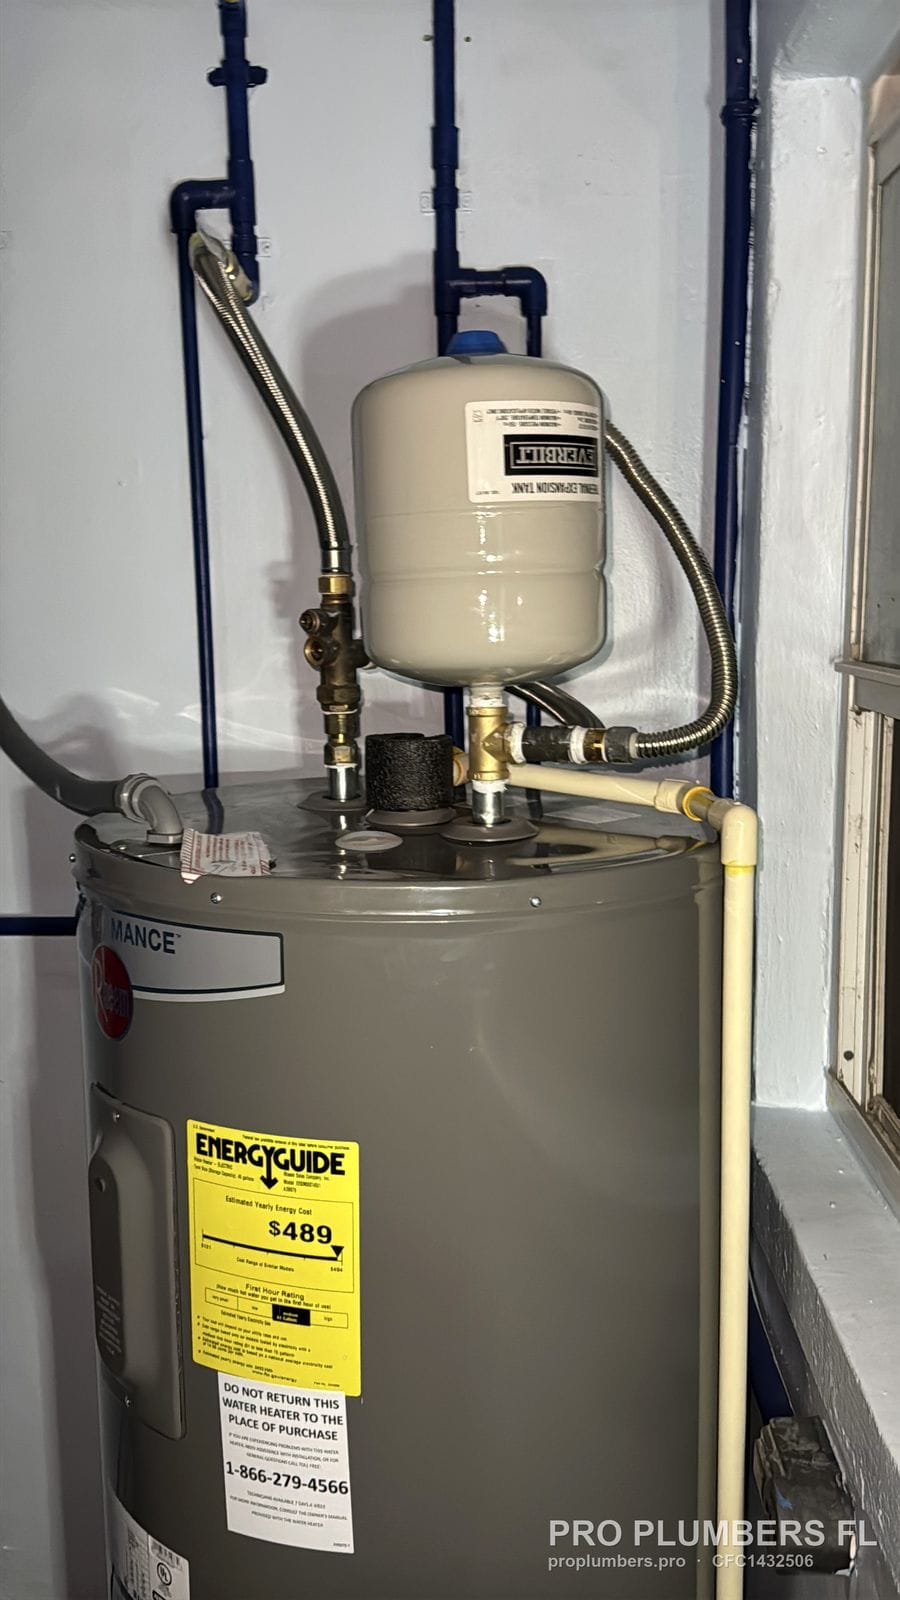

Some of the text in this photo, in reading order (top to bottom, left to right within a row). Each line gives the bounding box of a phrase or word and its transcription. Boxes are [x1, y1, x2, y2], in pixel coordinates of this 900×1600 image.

[516, 446, 595, 464] EVERBILT
[512, 482, 535, 494] TANK
[536, 482, 577, 494] EXPANSION
[196, 1132, 346, 1176] ENERGYGUIDE
[225, 1195, 253, 1207] Estimated
[255, 1201, 274, 1212] Yearly
[275, 1204, 296, 1215] Energy
[269, 1220, 332, 1244] $489
[246, 1283, 304, 1301] First Hour Rating
[224, 1382, 339, 1409] DO NOT RETURN THIS
[222, 1397, 343, 1425] WATER HEATER TO THE
[229, 1414, 338, 1441] PLACE OF PURCHASE
[226, 1462, 348, 1494] 1-866-279-4566
